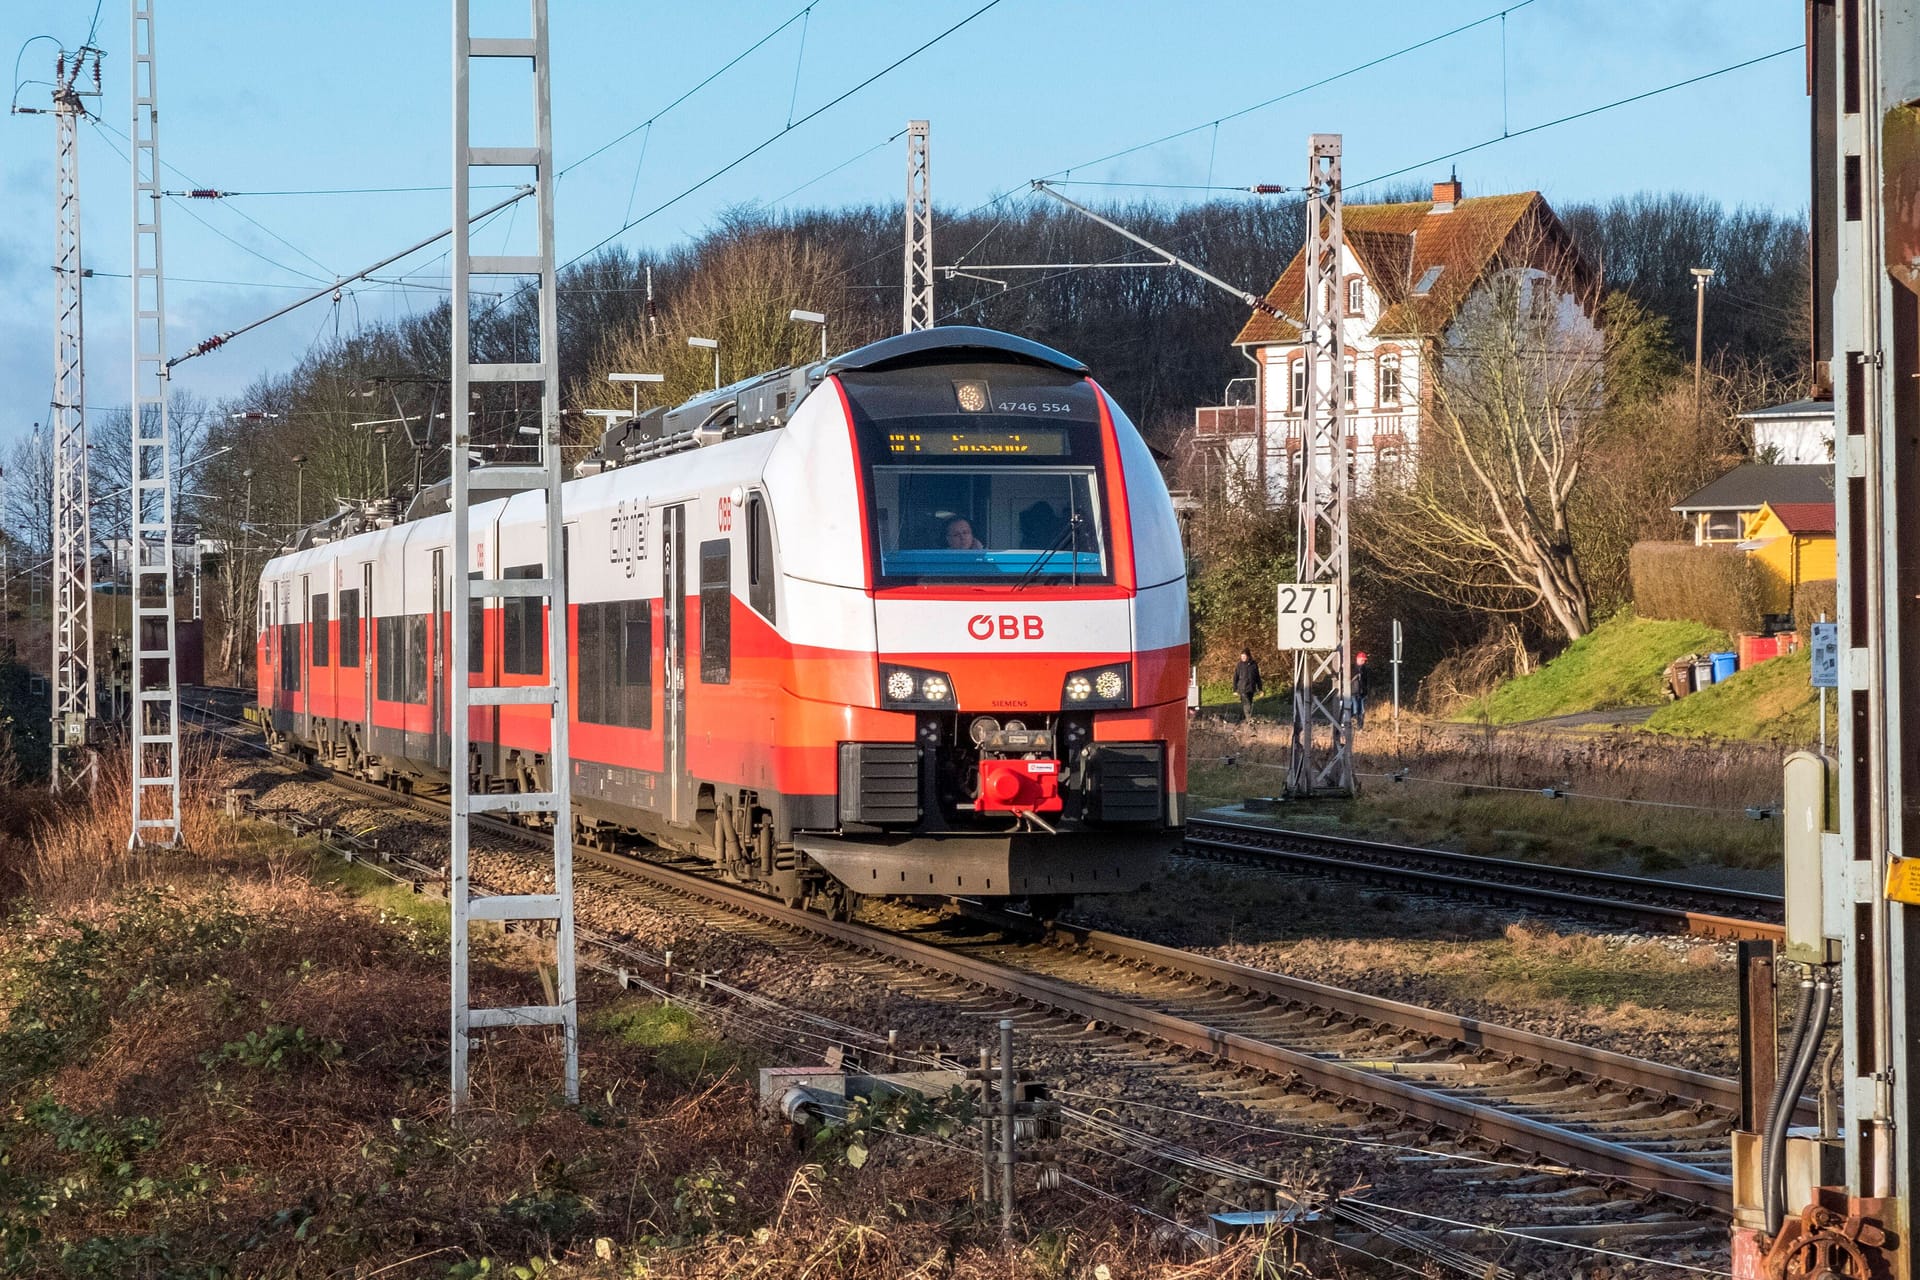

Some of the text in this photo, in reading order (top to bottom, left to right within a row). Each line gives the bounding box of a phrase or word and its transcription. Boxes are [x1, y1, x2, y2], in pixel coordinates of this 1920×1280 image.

[998, 402, 1071, 413] 4746 554
[1281, 588, 1332, 614] 271
[968, 615, 1044, 640] ÖBB
[1300, 617, 1316, 643] 8
